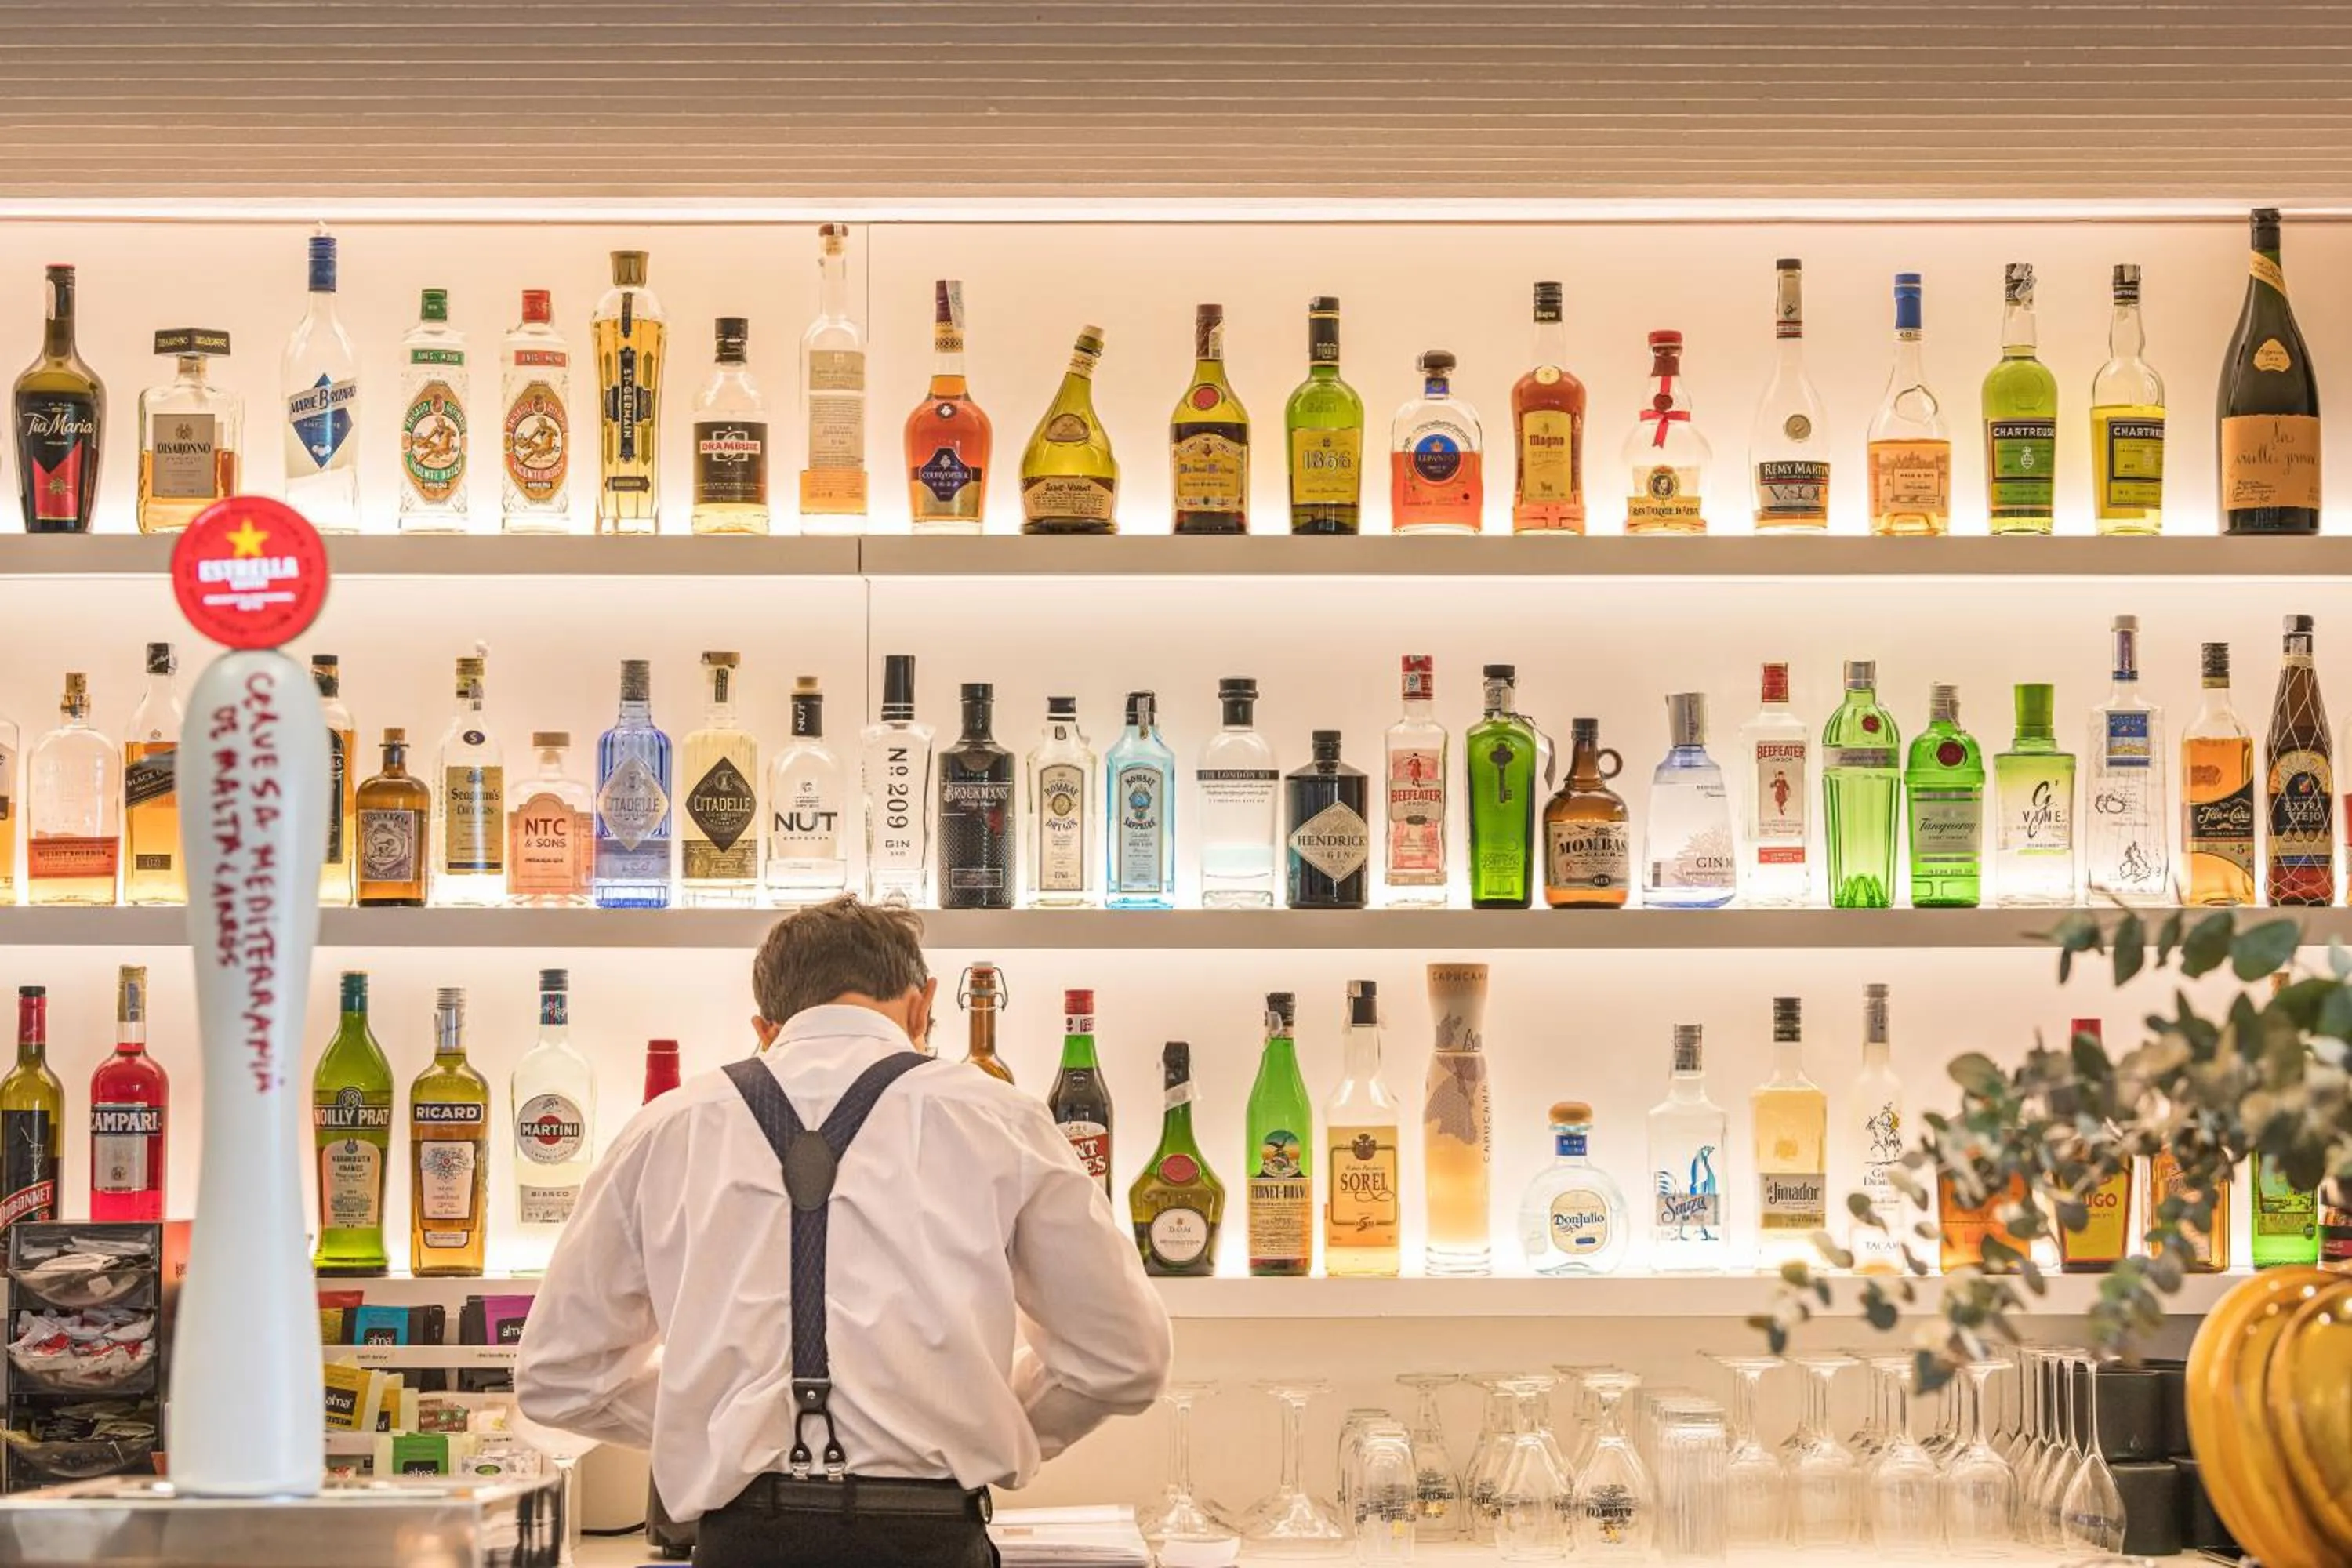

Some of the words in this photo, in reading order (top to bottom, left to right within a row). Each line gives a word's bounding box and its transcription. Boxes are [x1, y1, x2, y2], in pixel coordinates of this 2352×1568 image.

[289, 394, 318, 415] MARIE
[45, 413, 93, 436] Maria
[702, 442, 759, 451] DRAMBUIE
[1529, 434, 1565, 448] Magno
[157, 443, 211, 456] DISARONNO
[1303, 450, 1352, 470] 1866
[1757, 746, 1806, 759] BEEFEATER
[1218, 771, 1254, 779] LONDON
[694, 794, 750, 813] CITADELLE
[1392, 789, 1442, 803] BEEFEATER
[605, 795, 659, 813] CITADELLE
[887, 784, 909, 829] 209
[525, 818, 566, 836] NTC
[775, 812, 838, 832] NUT
[1918, 818, 1976, 833] Tanqueray
[524, 838, 532, 848] &
[536, 838, 566, 848] SONS
[1696, 857, 1722, 868] GIN
[314, 1109, 355, 1125] NOILLY
[358, 1109, 389, 1125] PRAT
[416, 1107, 477, 1119] RICARD
[521, 1124, 578, 1136] MARTINI
[1340, 1172, 1388, 1194] SOREL
[1769, 1181, 1820, 1205] Jimador
[502, 1325, 524, 1337] alm
